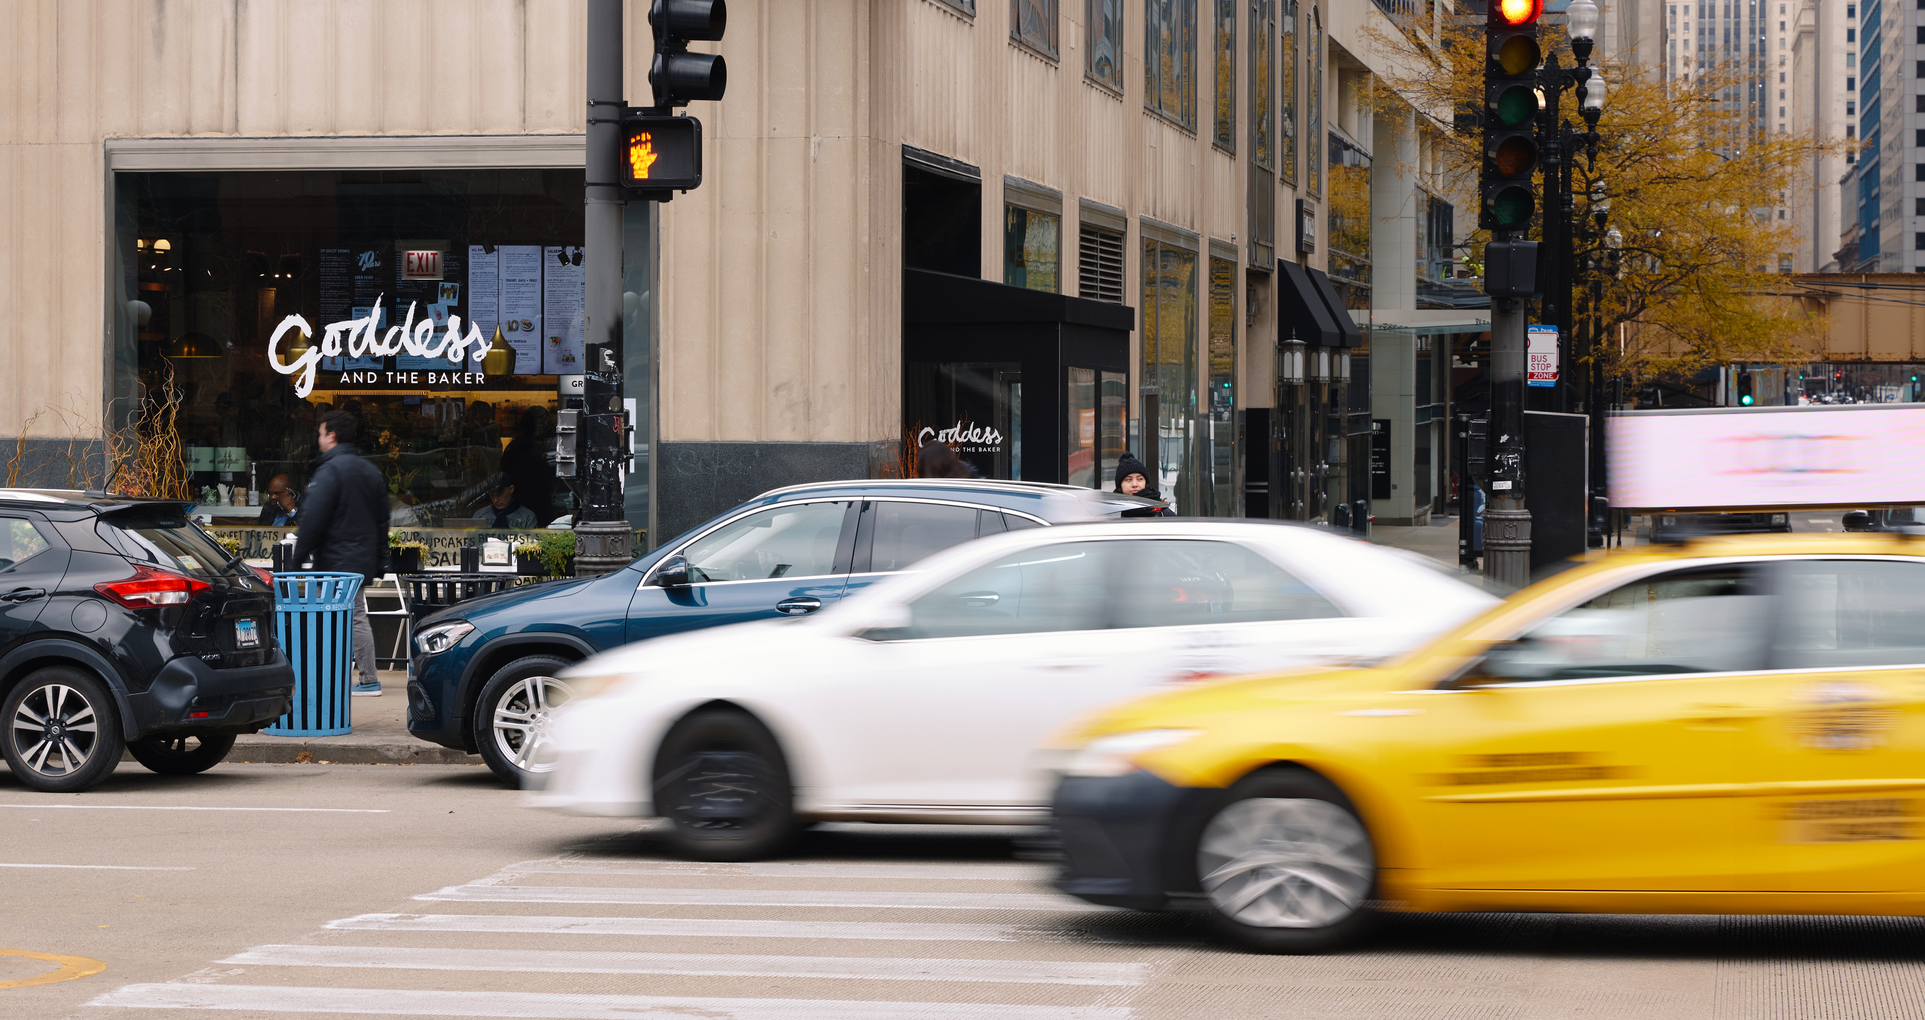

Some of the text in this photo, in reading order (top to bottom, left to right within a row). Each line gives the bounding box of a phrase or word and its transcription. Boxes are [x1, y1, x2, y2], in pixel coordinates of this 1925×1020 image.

[407, 252, 438, 272] EXIT
[268, 292, 493, 398] Goddess
[340, 372, 485, 384] AND THE BAKER
[918, 420, 1003, 448] Goddess
[245, 530, 278, 541] TREATS
[420, 537, 475, 548] CUPCAKES
